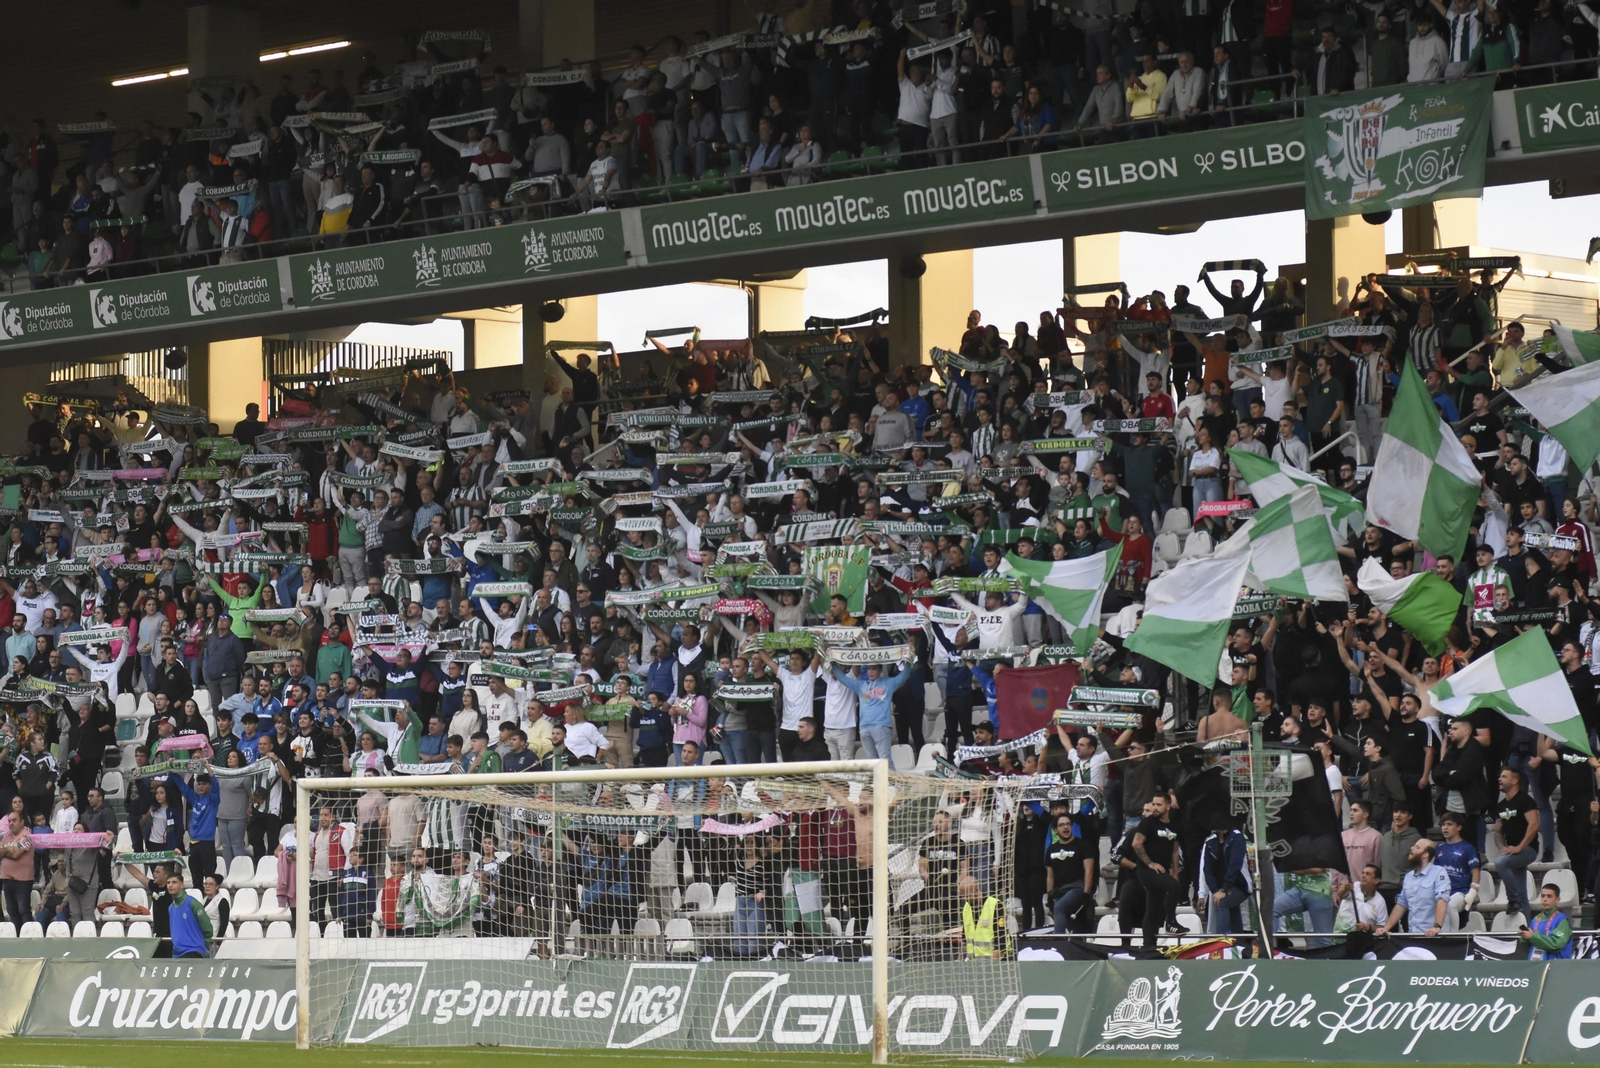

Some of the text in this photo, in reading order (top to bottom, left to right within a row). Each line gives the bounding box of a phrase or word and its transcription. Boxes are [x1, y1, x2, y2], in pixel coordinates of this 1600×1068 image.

[1415, 124, 1453, 145] Infantil
[1076, 140, 1305, 189] SILBON SILBO
[550, 227, 604, 247] AYUNTAMIENTO
[441, 242, 492, 261] AYUNTAMIENTO
[552, 245, 598, 263] DE CORDOBA
[334, 257, 385, 276] AYUNTAMIENTO
[442, 260, 486, 278] DE CORDOBA
[217, 275, 268, 293] Diputación
[336, 274, 379, 292] DE CORDOBA
[118, 289, 168, 306] Diputación
[219, 290, 270, 308] de Córdoba
[24, 302, 71, 319] Diputación
[121, 303, 171, 321] de Córdoba
[26, 315, 74, 333] de Córdoba
[687, 609, 698, 619] CF
[1521, 613, 1530, 621] DE
[139, 966, 252, 979] DESDE 1904
[1409, 976, 1530, 989] BODEGA Y VIÑEDOS
[69, 971, 297, 1040] Cruzcampo
[358, 982, 413, 1020] RG3
[420, 979, 615, 1027] rg3print.es
[620, 985, 682, 1025] RG3
[1205, 964, 1522, 1056] Pérez Barquero
[772, 994, 1068, 1047] GIVOVA
[1095, 1044, 1115, 1052] CASA
[1115, 1044, 1150, 1053] FUNDADA
[1151, 1044, 1161, 1052] EN
